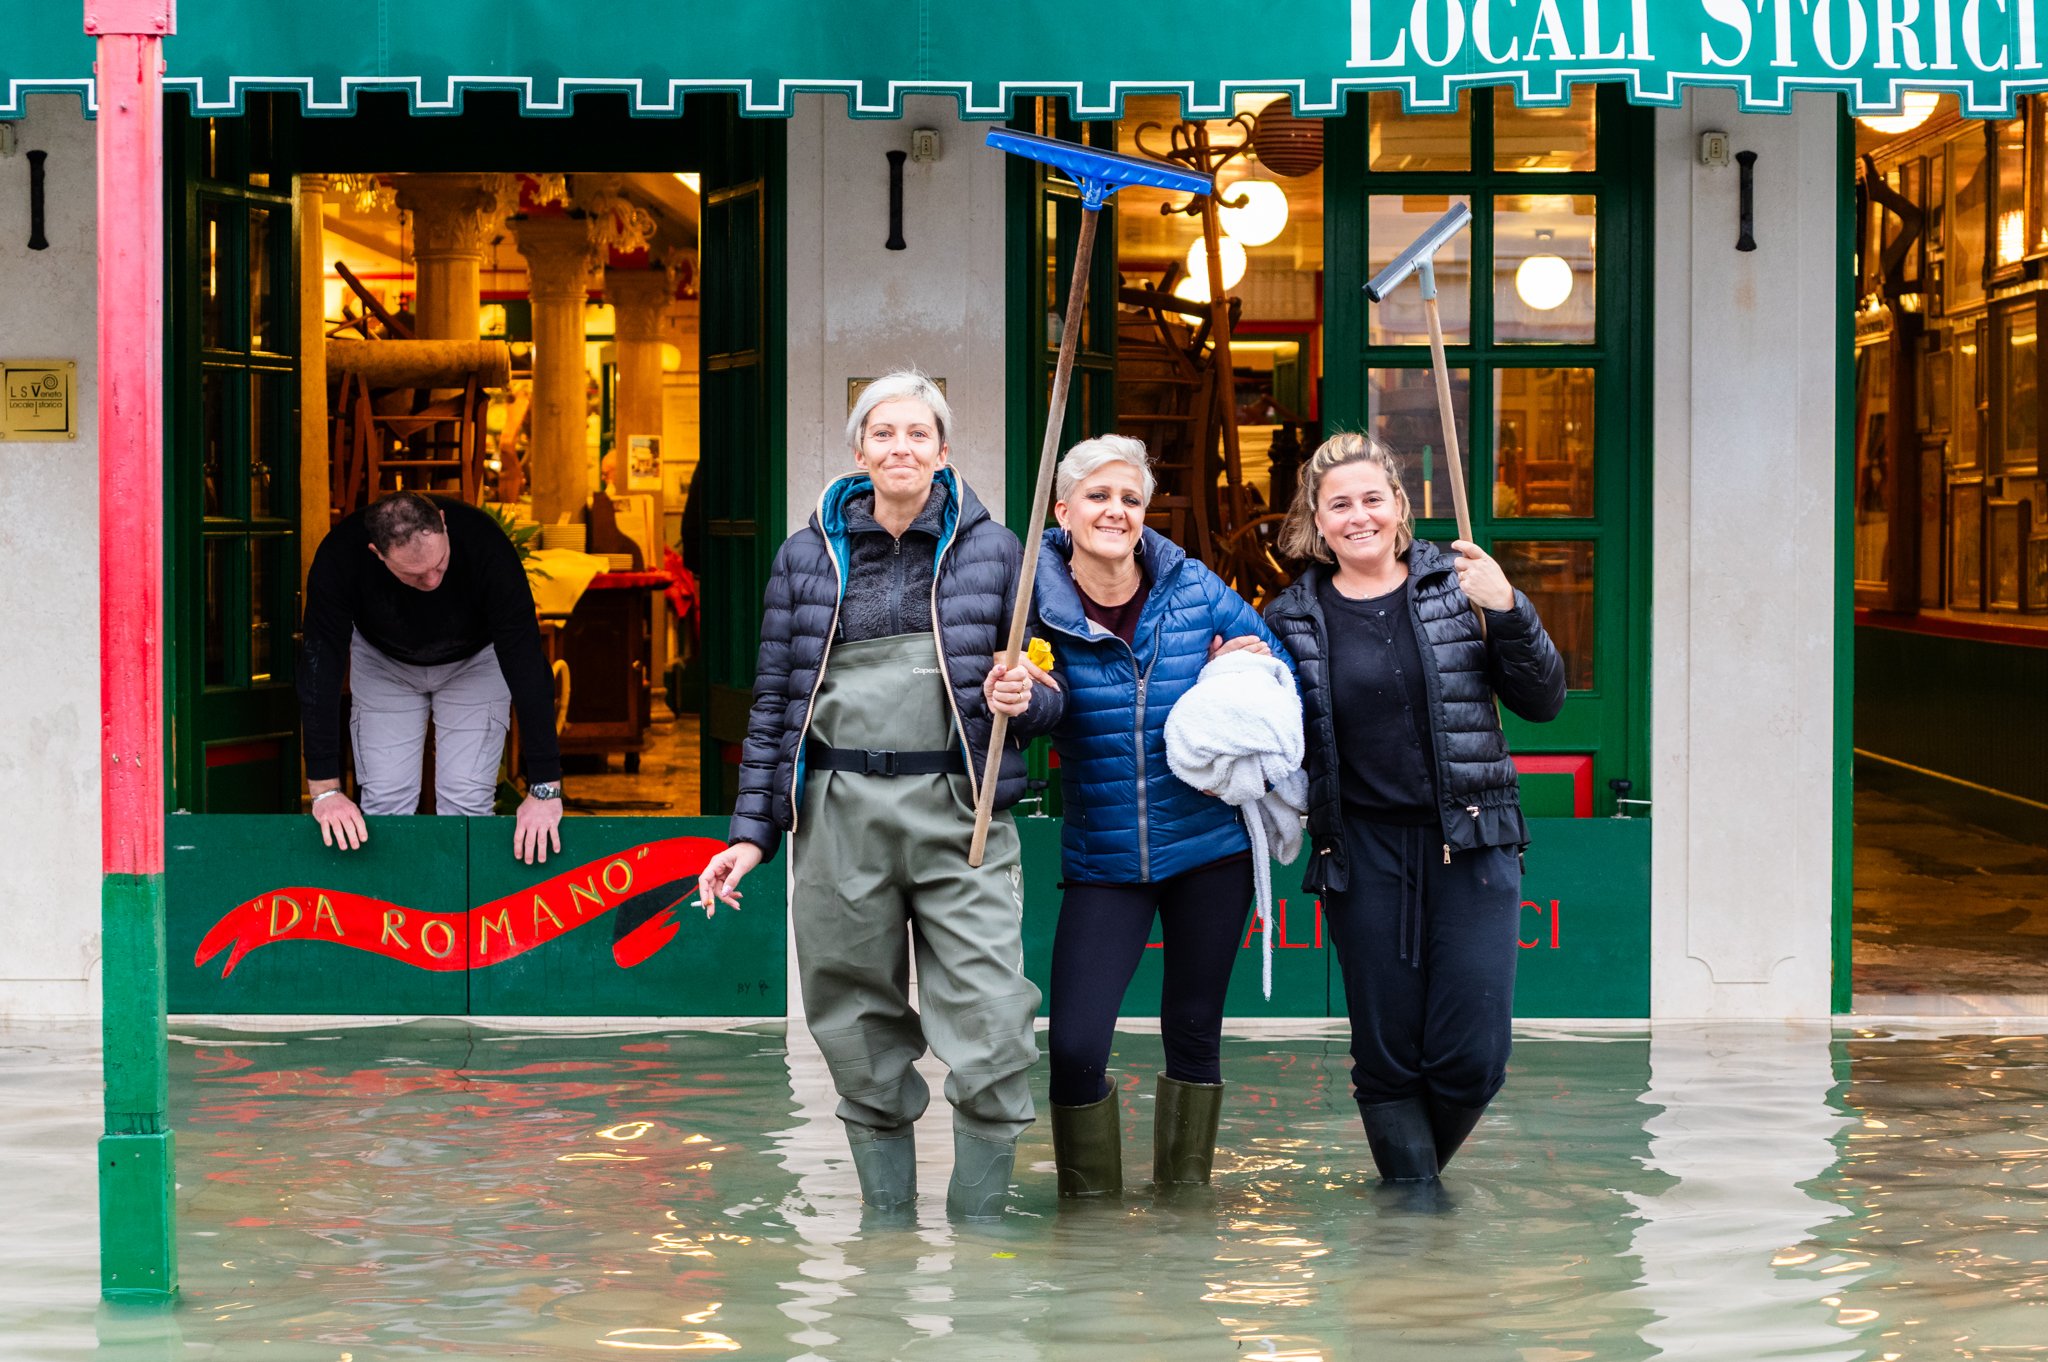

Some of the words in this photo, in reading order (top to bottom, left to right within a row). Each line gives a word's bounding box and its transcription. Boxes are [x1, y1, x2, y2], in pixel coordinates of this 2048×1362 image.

[1345, 0, 1656, 68] LOCALI
[1700, 0, 2043, 72] STORICI
[381, 847, 650, 960] ROMANO"
